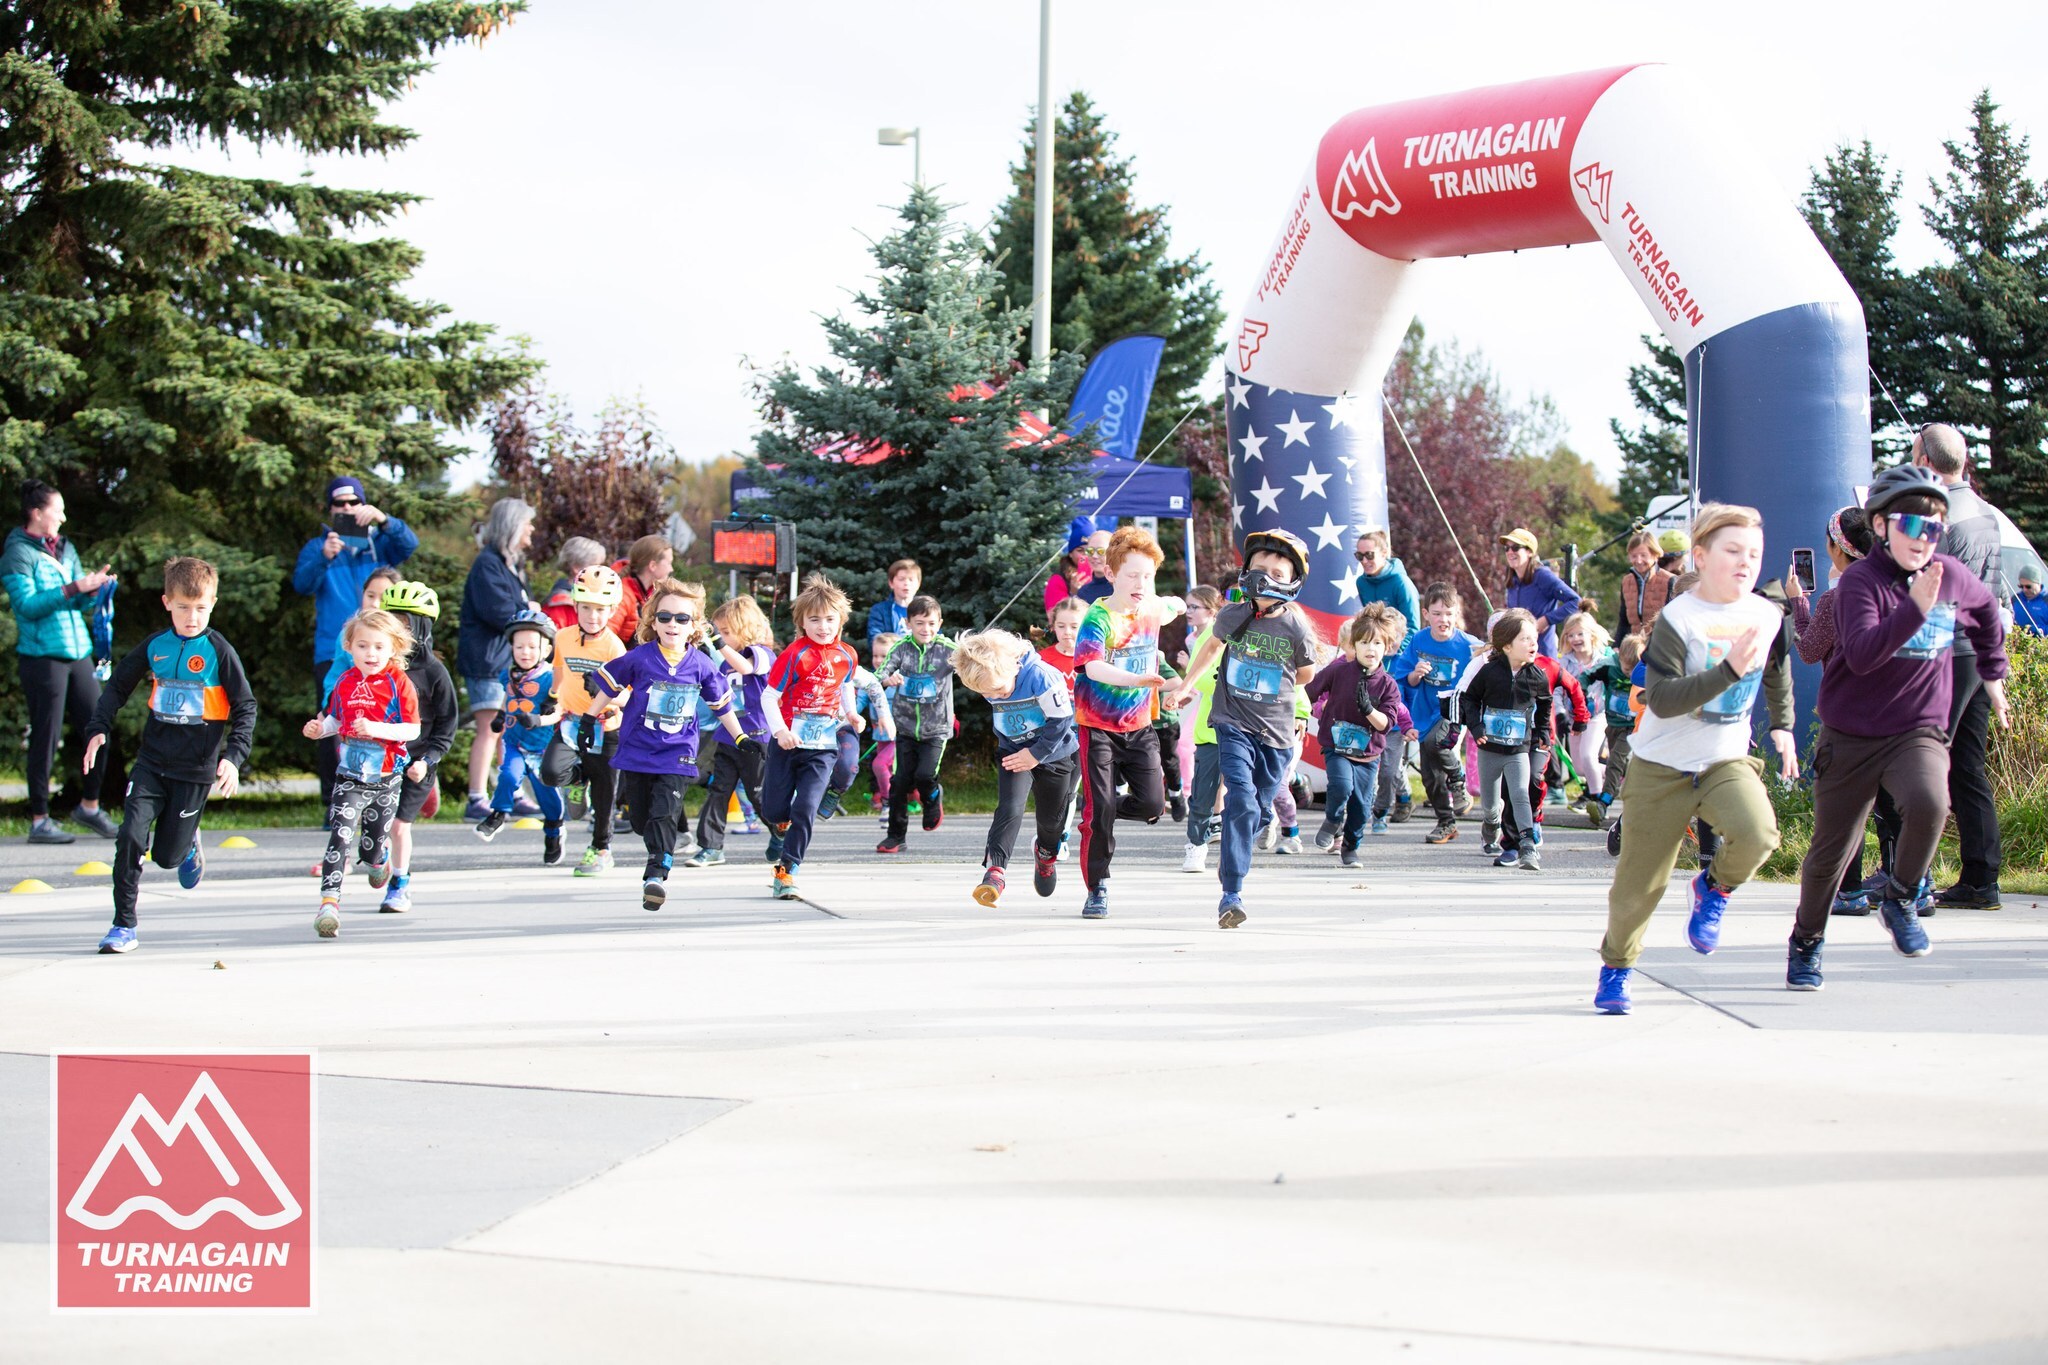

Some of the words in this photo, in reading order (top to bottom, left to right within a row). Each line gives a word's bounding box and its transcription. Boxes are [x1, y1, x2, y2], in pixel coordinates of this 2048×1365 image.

[1404, 116, 1566, 168] TURNAGAIN
[1429, 161, 1537, 199] TRAINING
[1257, 185, 1310, 302] TURNAGAIN
[1273, 218, 1311, 296] TRAINING
[1621, 201, 1704, 327] TURNAGAIN
[1627, 239, 1679, 322] TRAINING
[910, 680, 924, 696] 20
[1243, 668, 1261, 690] 31
[166, 691, 187, 712] 42
[666, 695, 686, 714] 68
[1729, 684, 1753, 710] 34
[807, 724, 823, 741] 56
[1007, 714, 1028, 735] 33
[1496, 719, 1513, 736] 26
